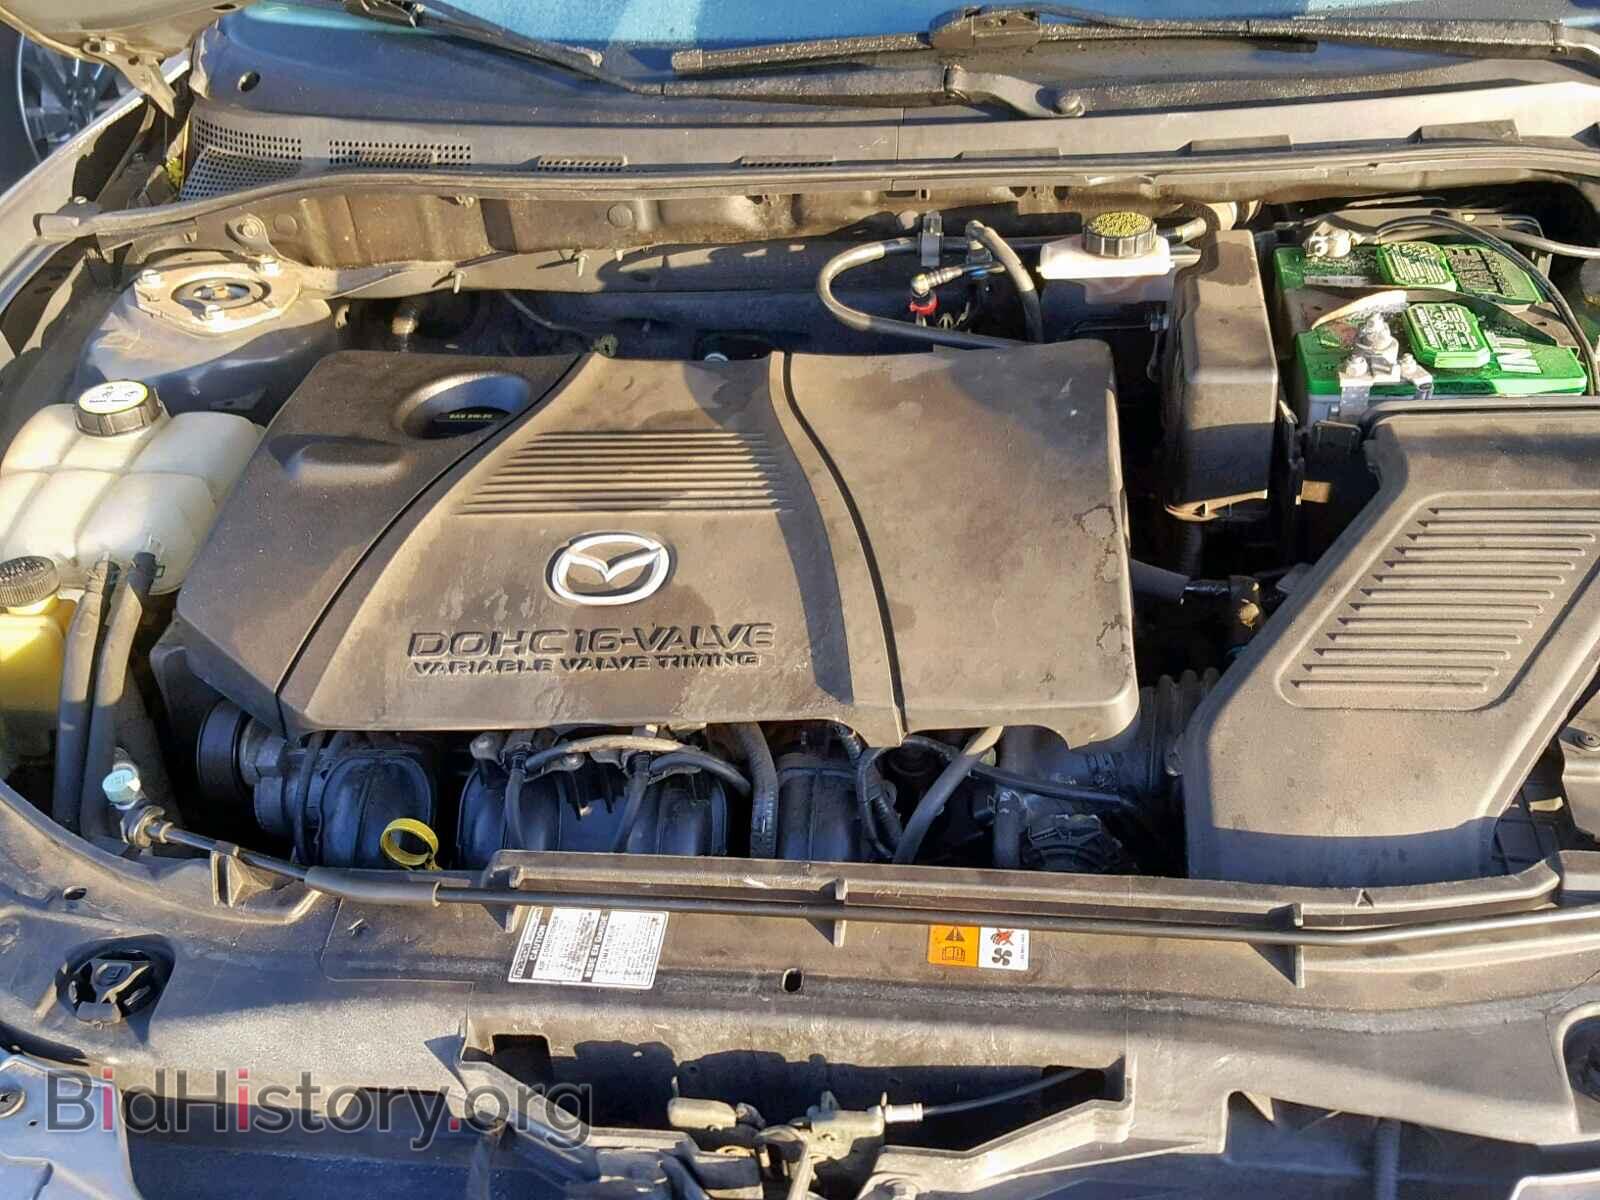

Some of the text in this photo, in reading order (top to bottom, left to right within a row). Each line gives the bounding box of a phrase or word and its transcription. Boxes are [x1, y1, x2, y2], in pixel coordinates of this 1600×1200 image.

[407, 622, 776, 657] DOHC 16-VALVE
[411, 650, 763, 675] VARIABLE VALVE TIMING
[528, 924, 545, 960] CAUTION
